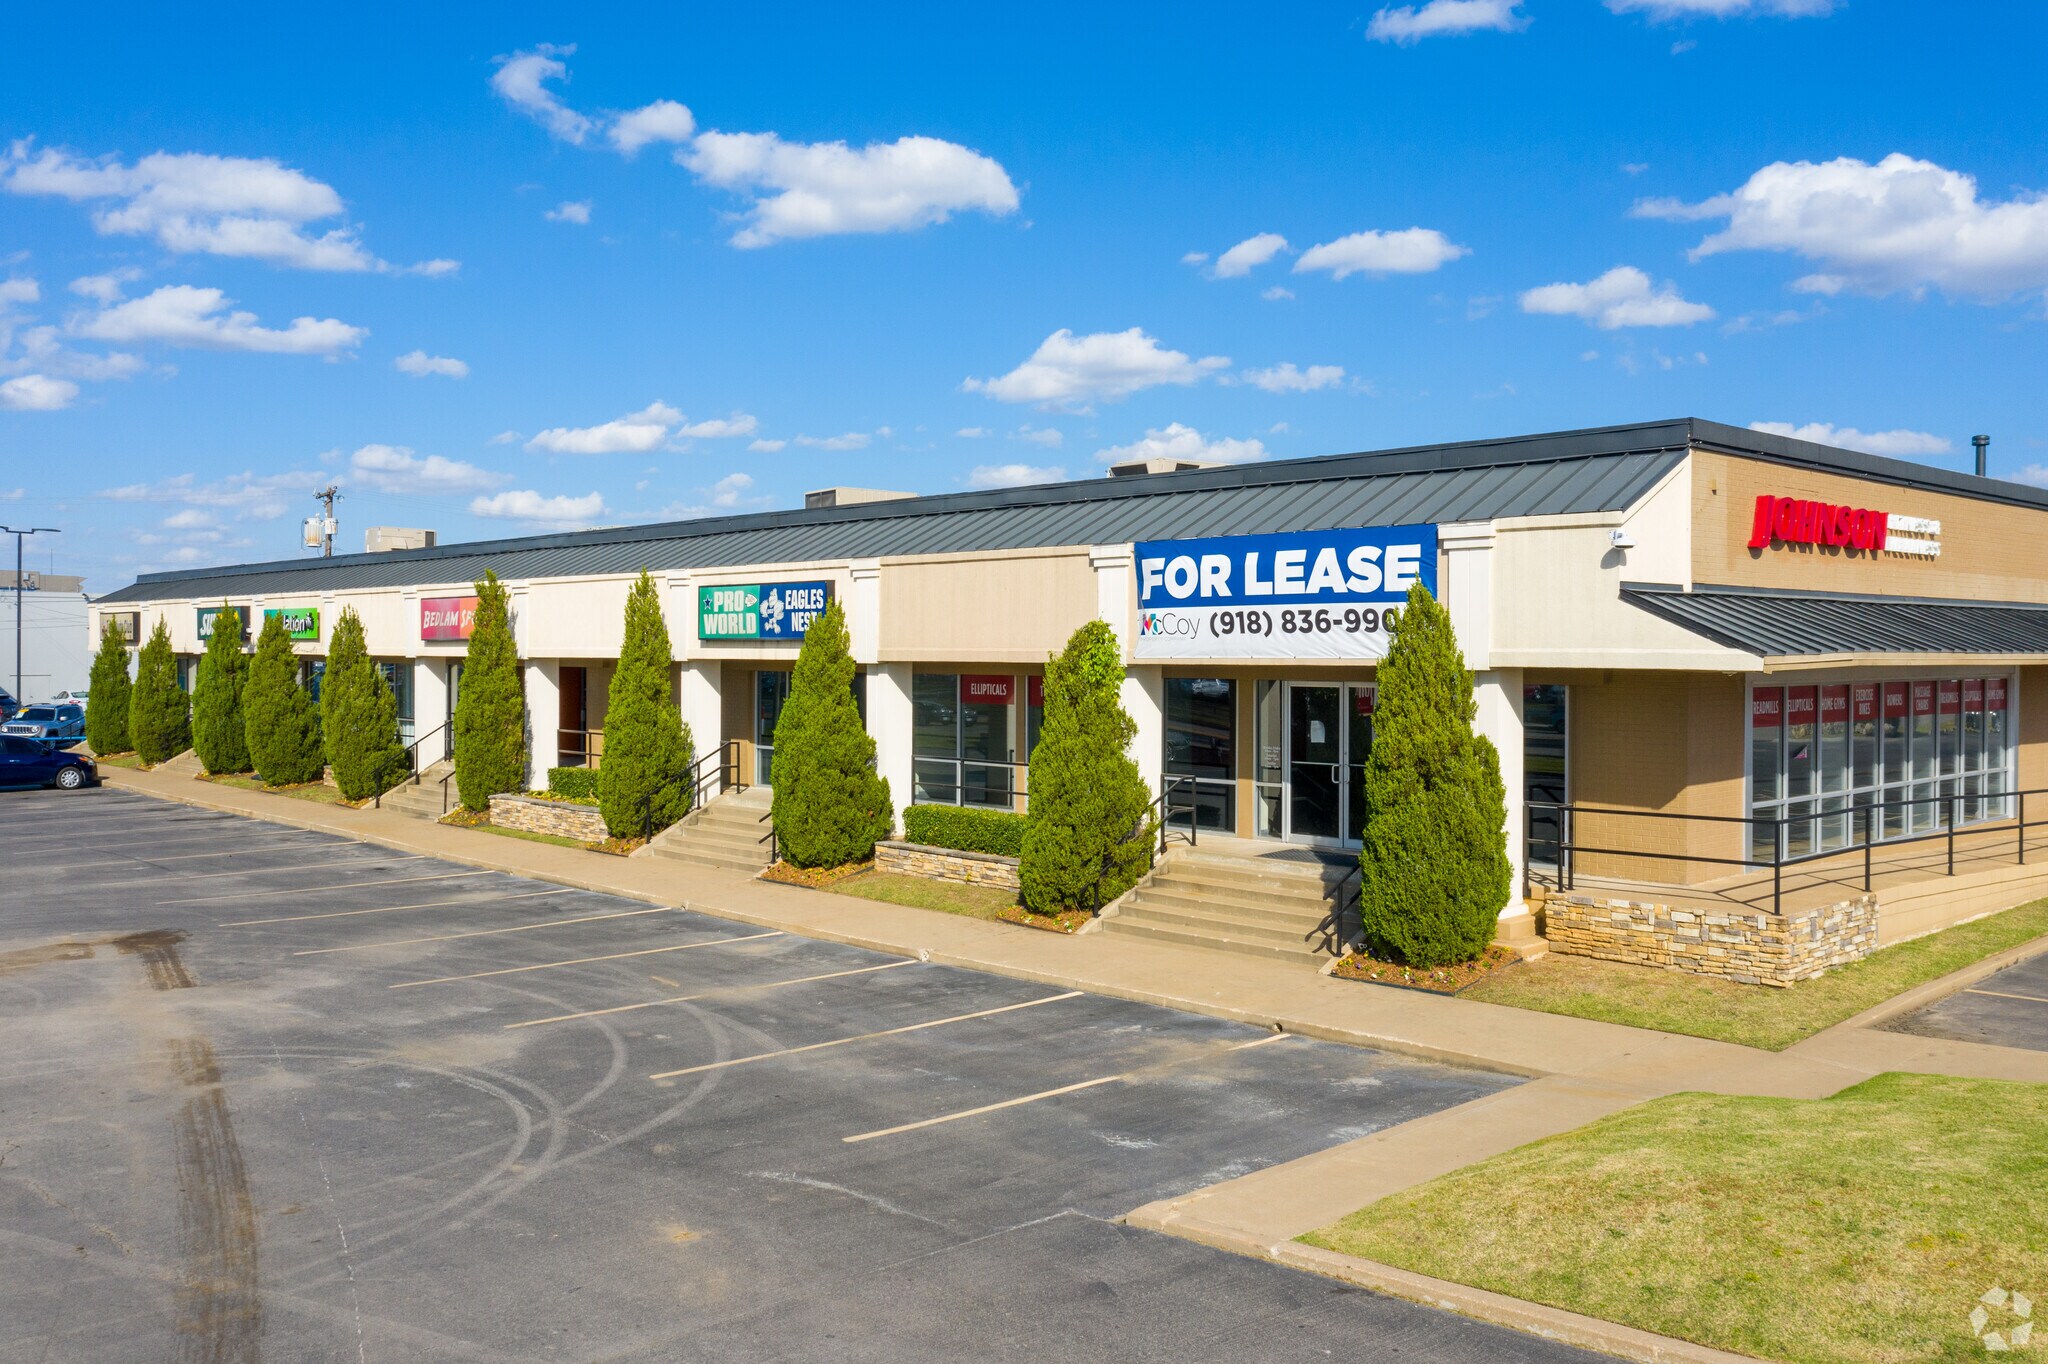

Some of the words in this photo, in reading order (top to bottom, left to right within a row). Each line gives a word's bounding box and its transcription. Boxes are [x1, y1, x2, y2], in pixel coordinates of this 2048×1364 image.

[1747, 495, 1889, 551] JOHNSON
[1141, 554, 1232, 600] FOR
[1244, 543, 1422, 597] LEASE
[713, 590, 744, 612] PRO
[785, 588, 824, 610] EAGLES
[423, 610, 459, 629] BEDLAM
[703, 612, 757, 635] WORLD
[1140, 612, 1201, 640] McCoy
[1209, 610, 1273, 638] (918)
[1281, 607, 1395, 635] 836-990
[970, 683, 1007, 696] ELLIPTICALS
[1753, 701, 1779, 715] READMILLS
